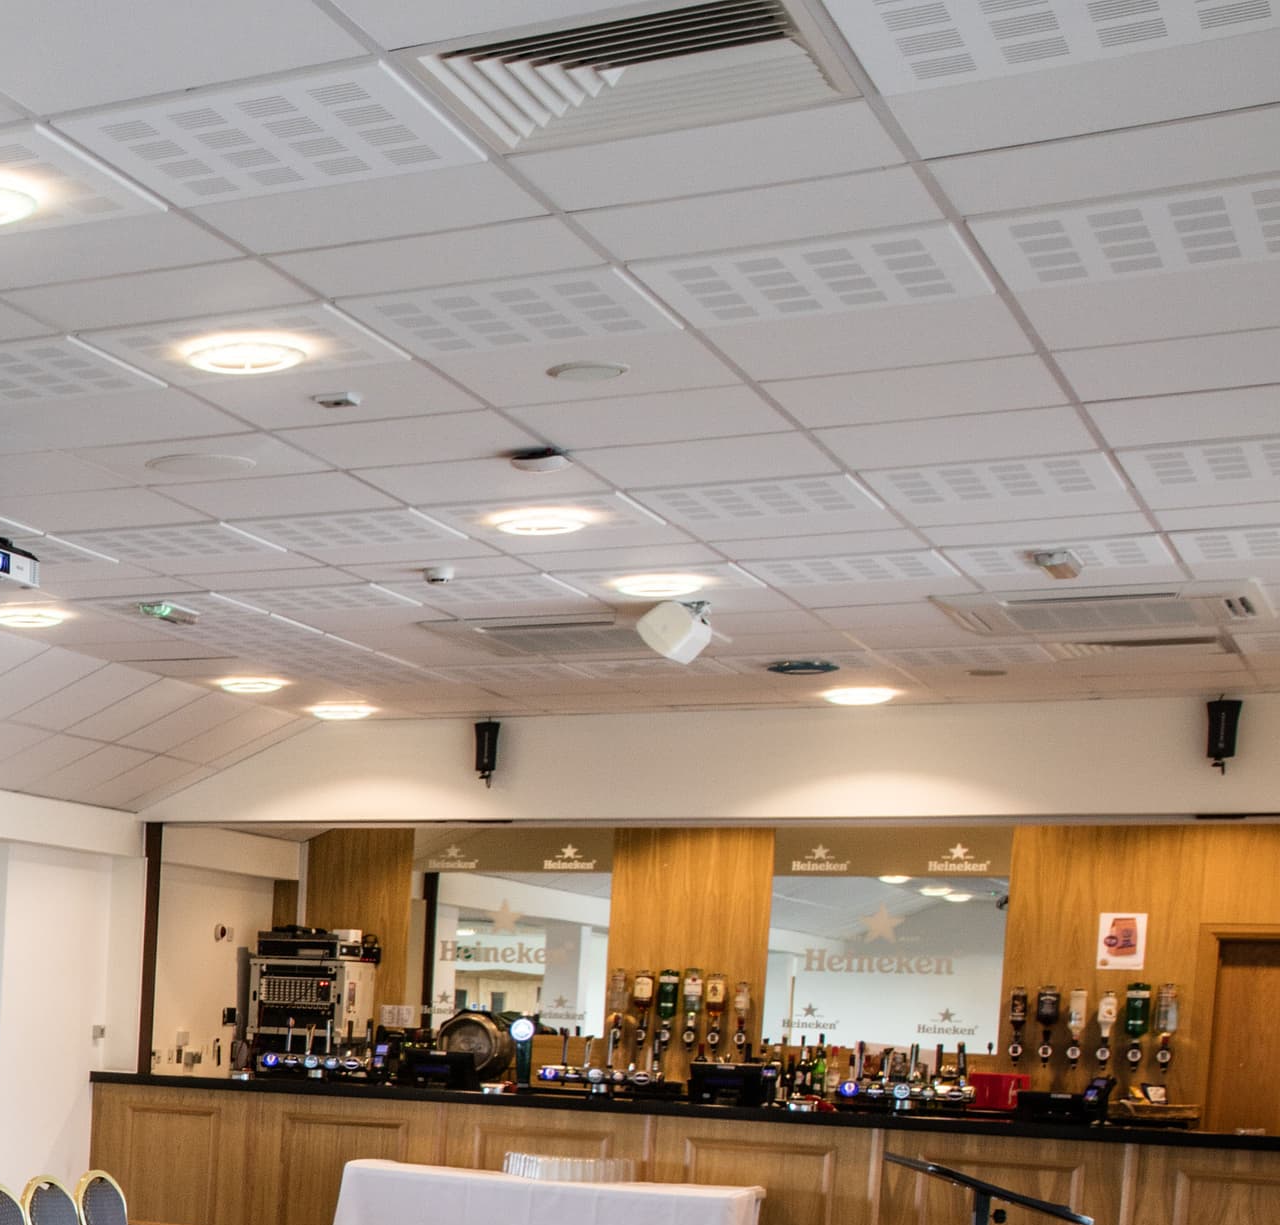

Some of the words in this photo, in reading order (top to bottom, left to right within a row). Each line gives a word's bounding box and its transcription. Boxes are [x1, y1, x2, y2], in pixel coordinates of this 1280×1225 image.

[428, 859, 476, 869] Heineken
[543, 860, 594, 870] Heineken
[791, 861, 848, 872] Heineken
[928, 861, 988, 872] Heineken
[803, 948, 955, 976] Heineken
[782, 1018, 837, 1030] Heineken
[917, 1024, 976, 1036] Heineken
